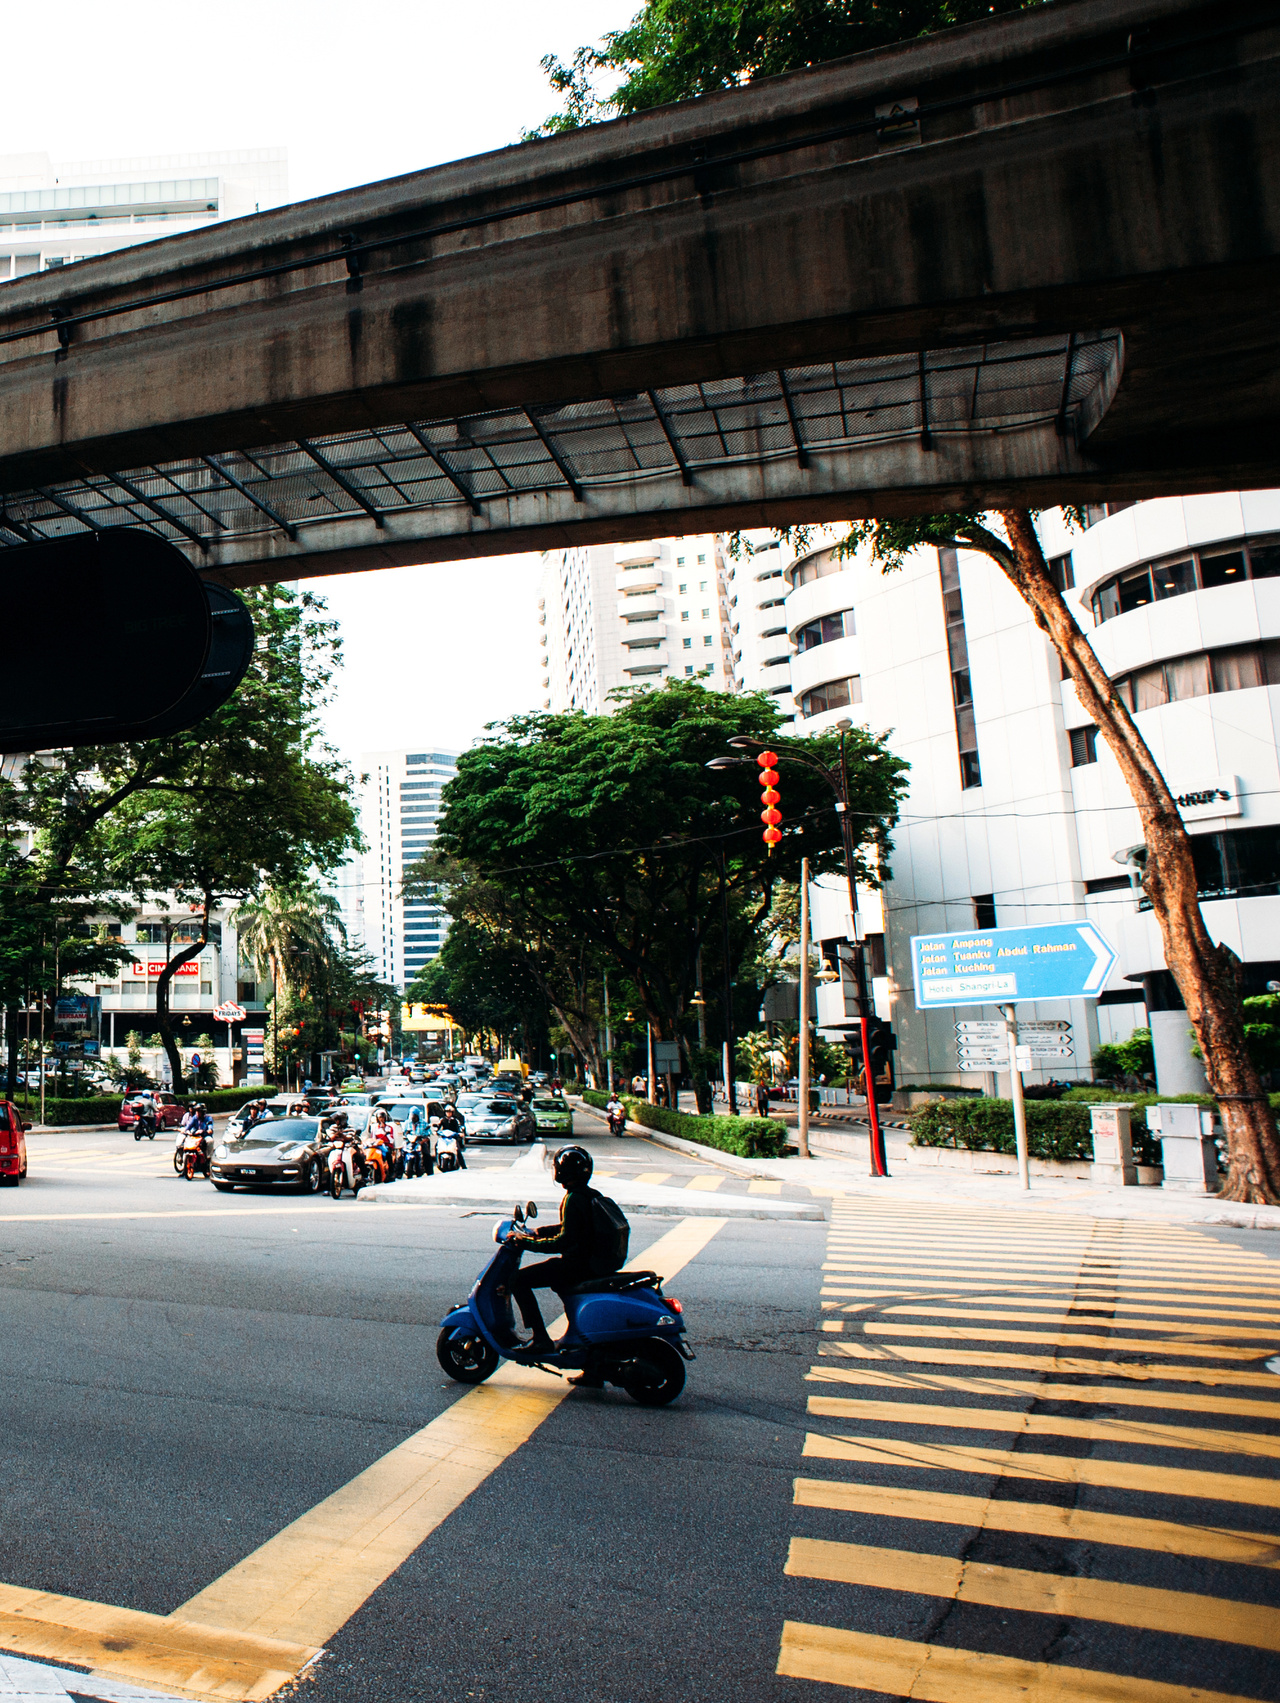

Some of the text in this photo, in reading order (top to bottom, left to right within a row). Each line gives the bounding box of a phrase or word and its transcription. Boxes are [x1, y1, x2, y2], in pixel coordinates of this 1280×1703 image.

[124, 620, 148, 634] BIG
[919, 937, 993, 952] Jalan Ampang
[920, 942, 1077, 964] Jalan Tuanku Abdul Rahman
[148, 964, 198, 973] CIM ANK
[921, 962, 996, 977] Jalan Kuching
[929, 983, 953, 993] Hotel
